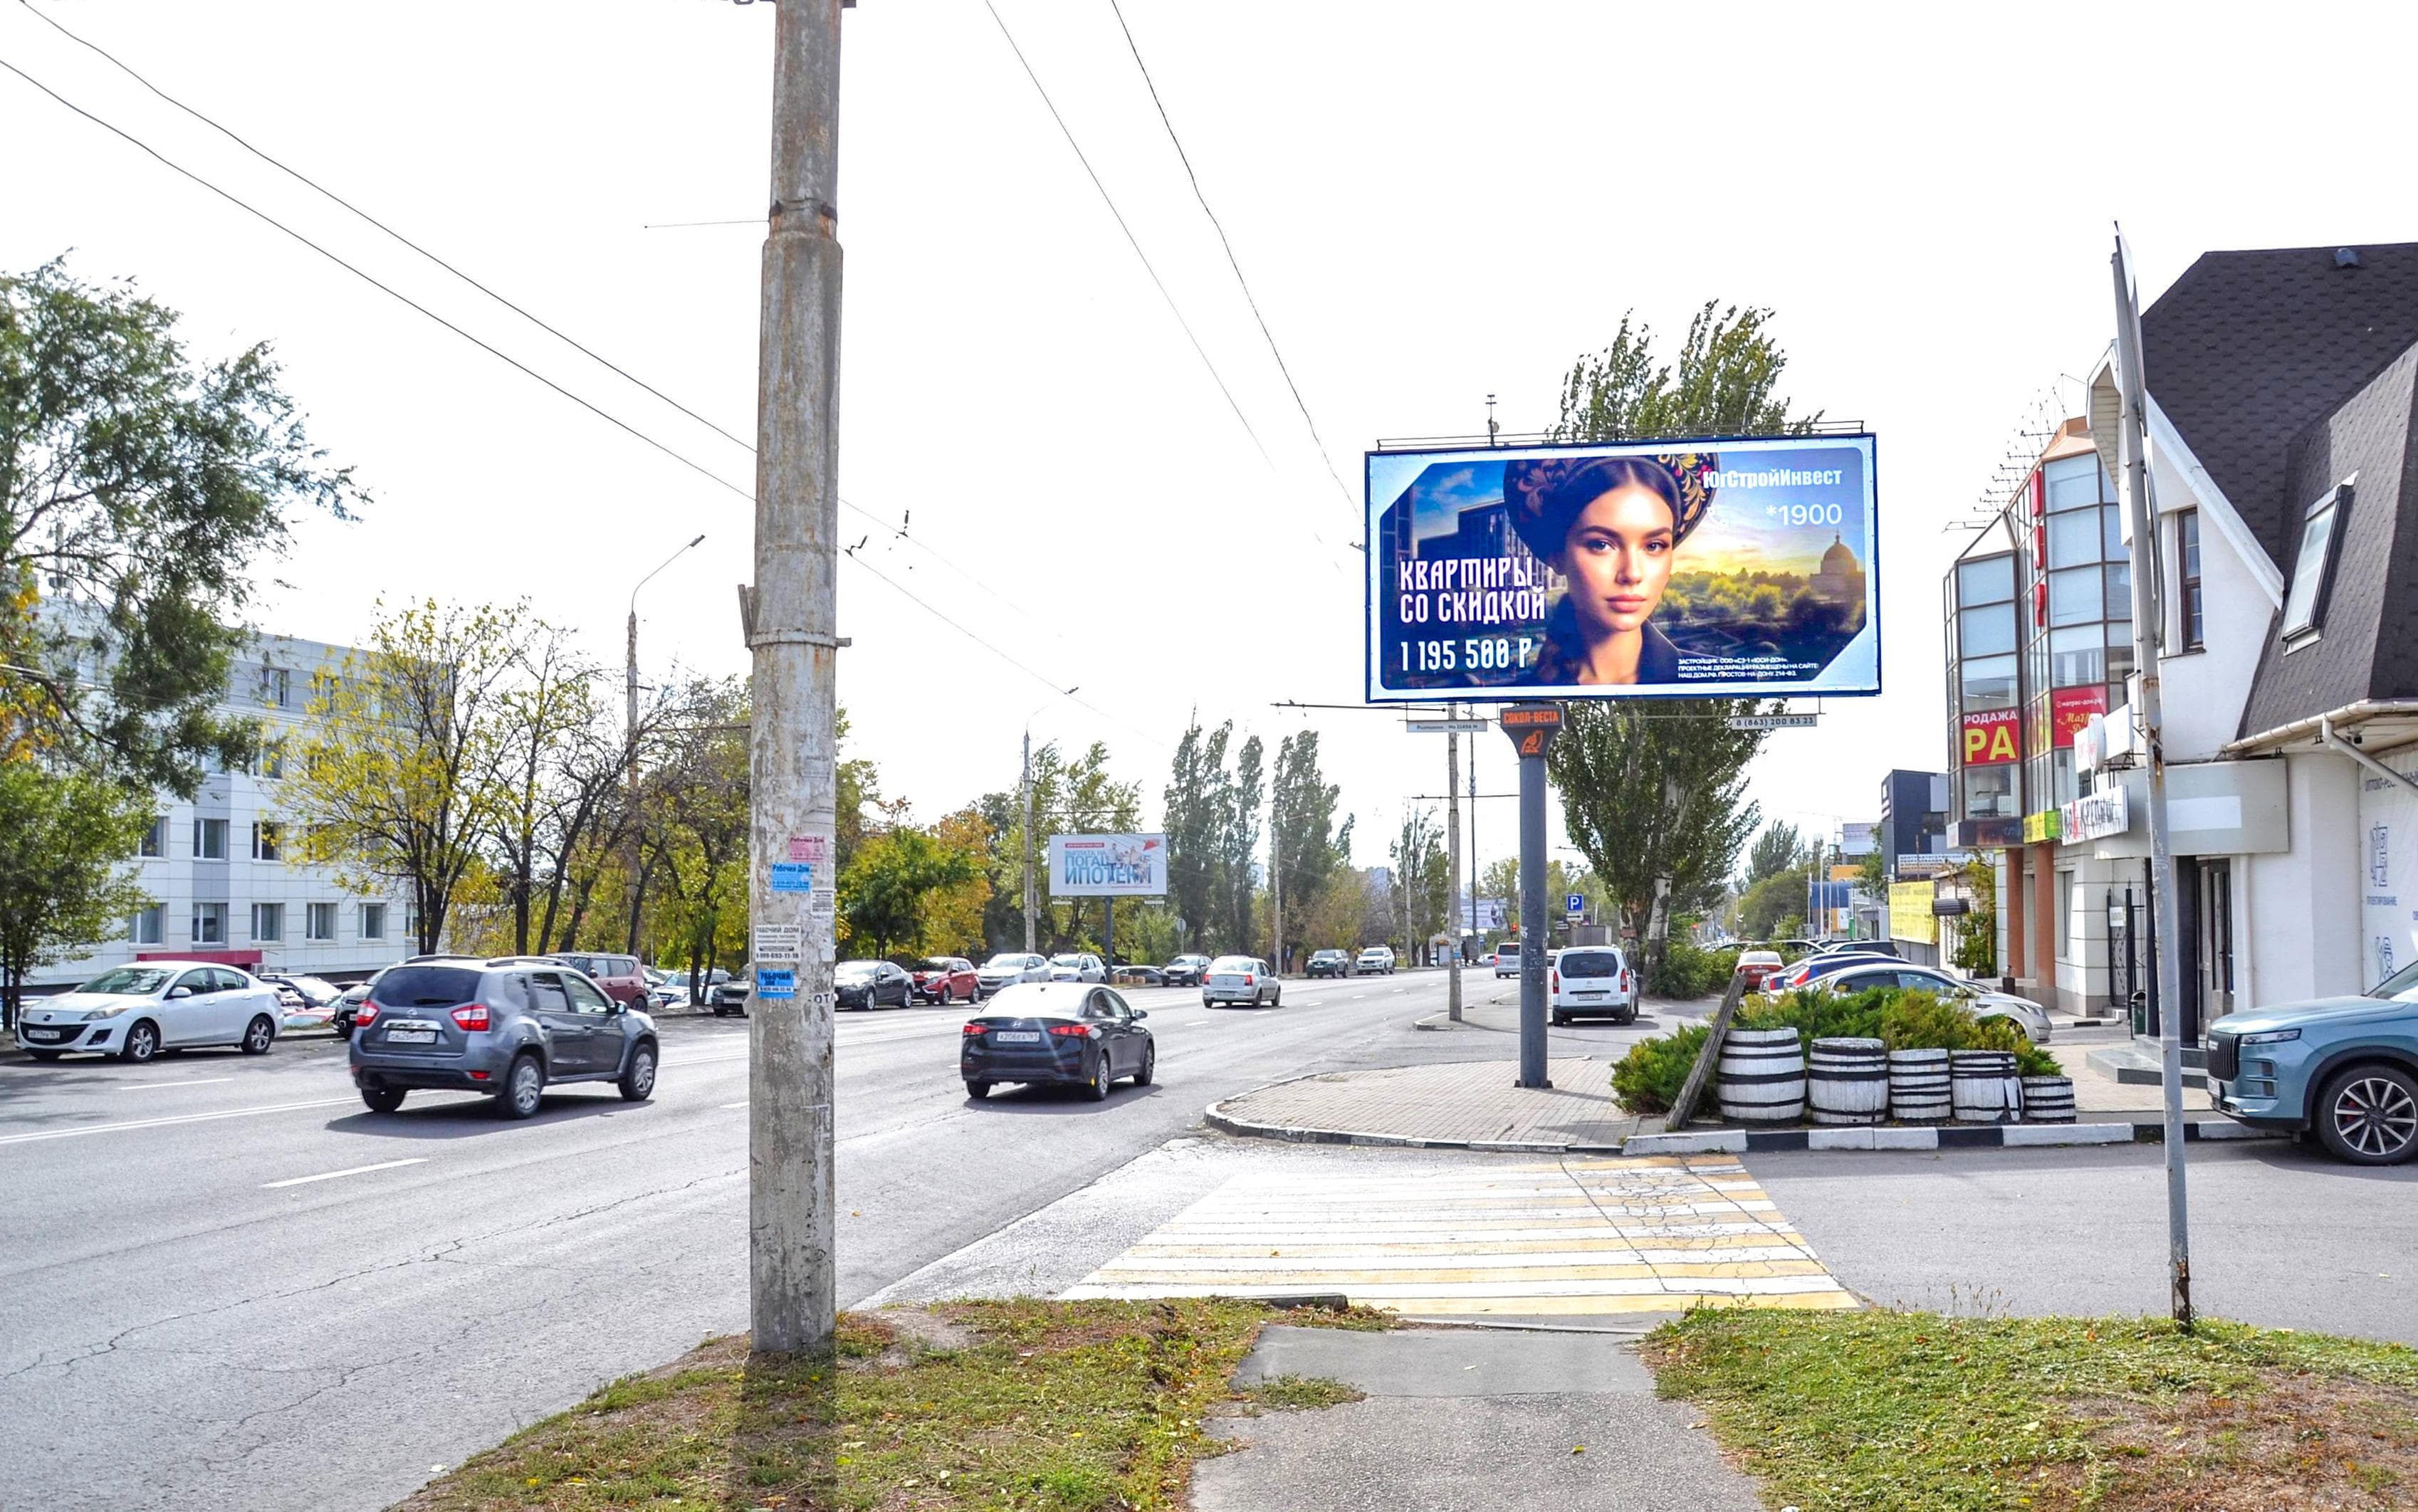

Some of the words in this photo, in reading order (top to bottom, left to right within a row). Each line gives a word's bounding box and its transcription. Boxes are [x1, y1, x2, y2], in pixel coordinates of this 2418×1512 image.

[1703, 468, 1843, 489] ЮгСтройИнвест
[1401, 557, 1532, 590] КВАРТИРЫ
[1400, 593, 1428, 624] СО
[1438, 585, 1545, 624] СКИДКОЙ
[1401, 641, 1408, 671] 1
[1418, 640, 1456, 671] 195
[1465, 639, 1509, 669] 500
[1503, 710, 1559, 724] СОКОЛ-ВЕСТА
[1964, 710, 2018, 725] РОДАЖА
[1965, 725, 2016, 762] РА
[1569, 896, 1580, 910] P
